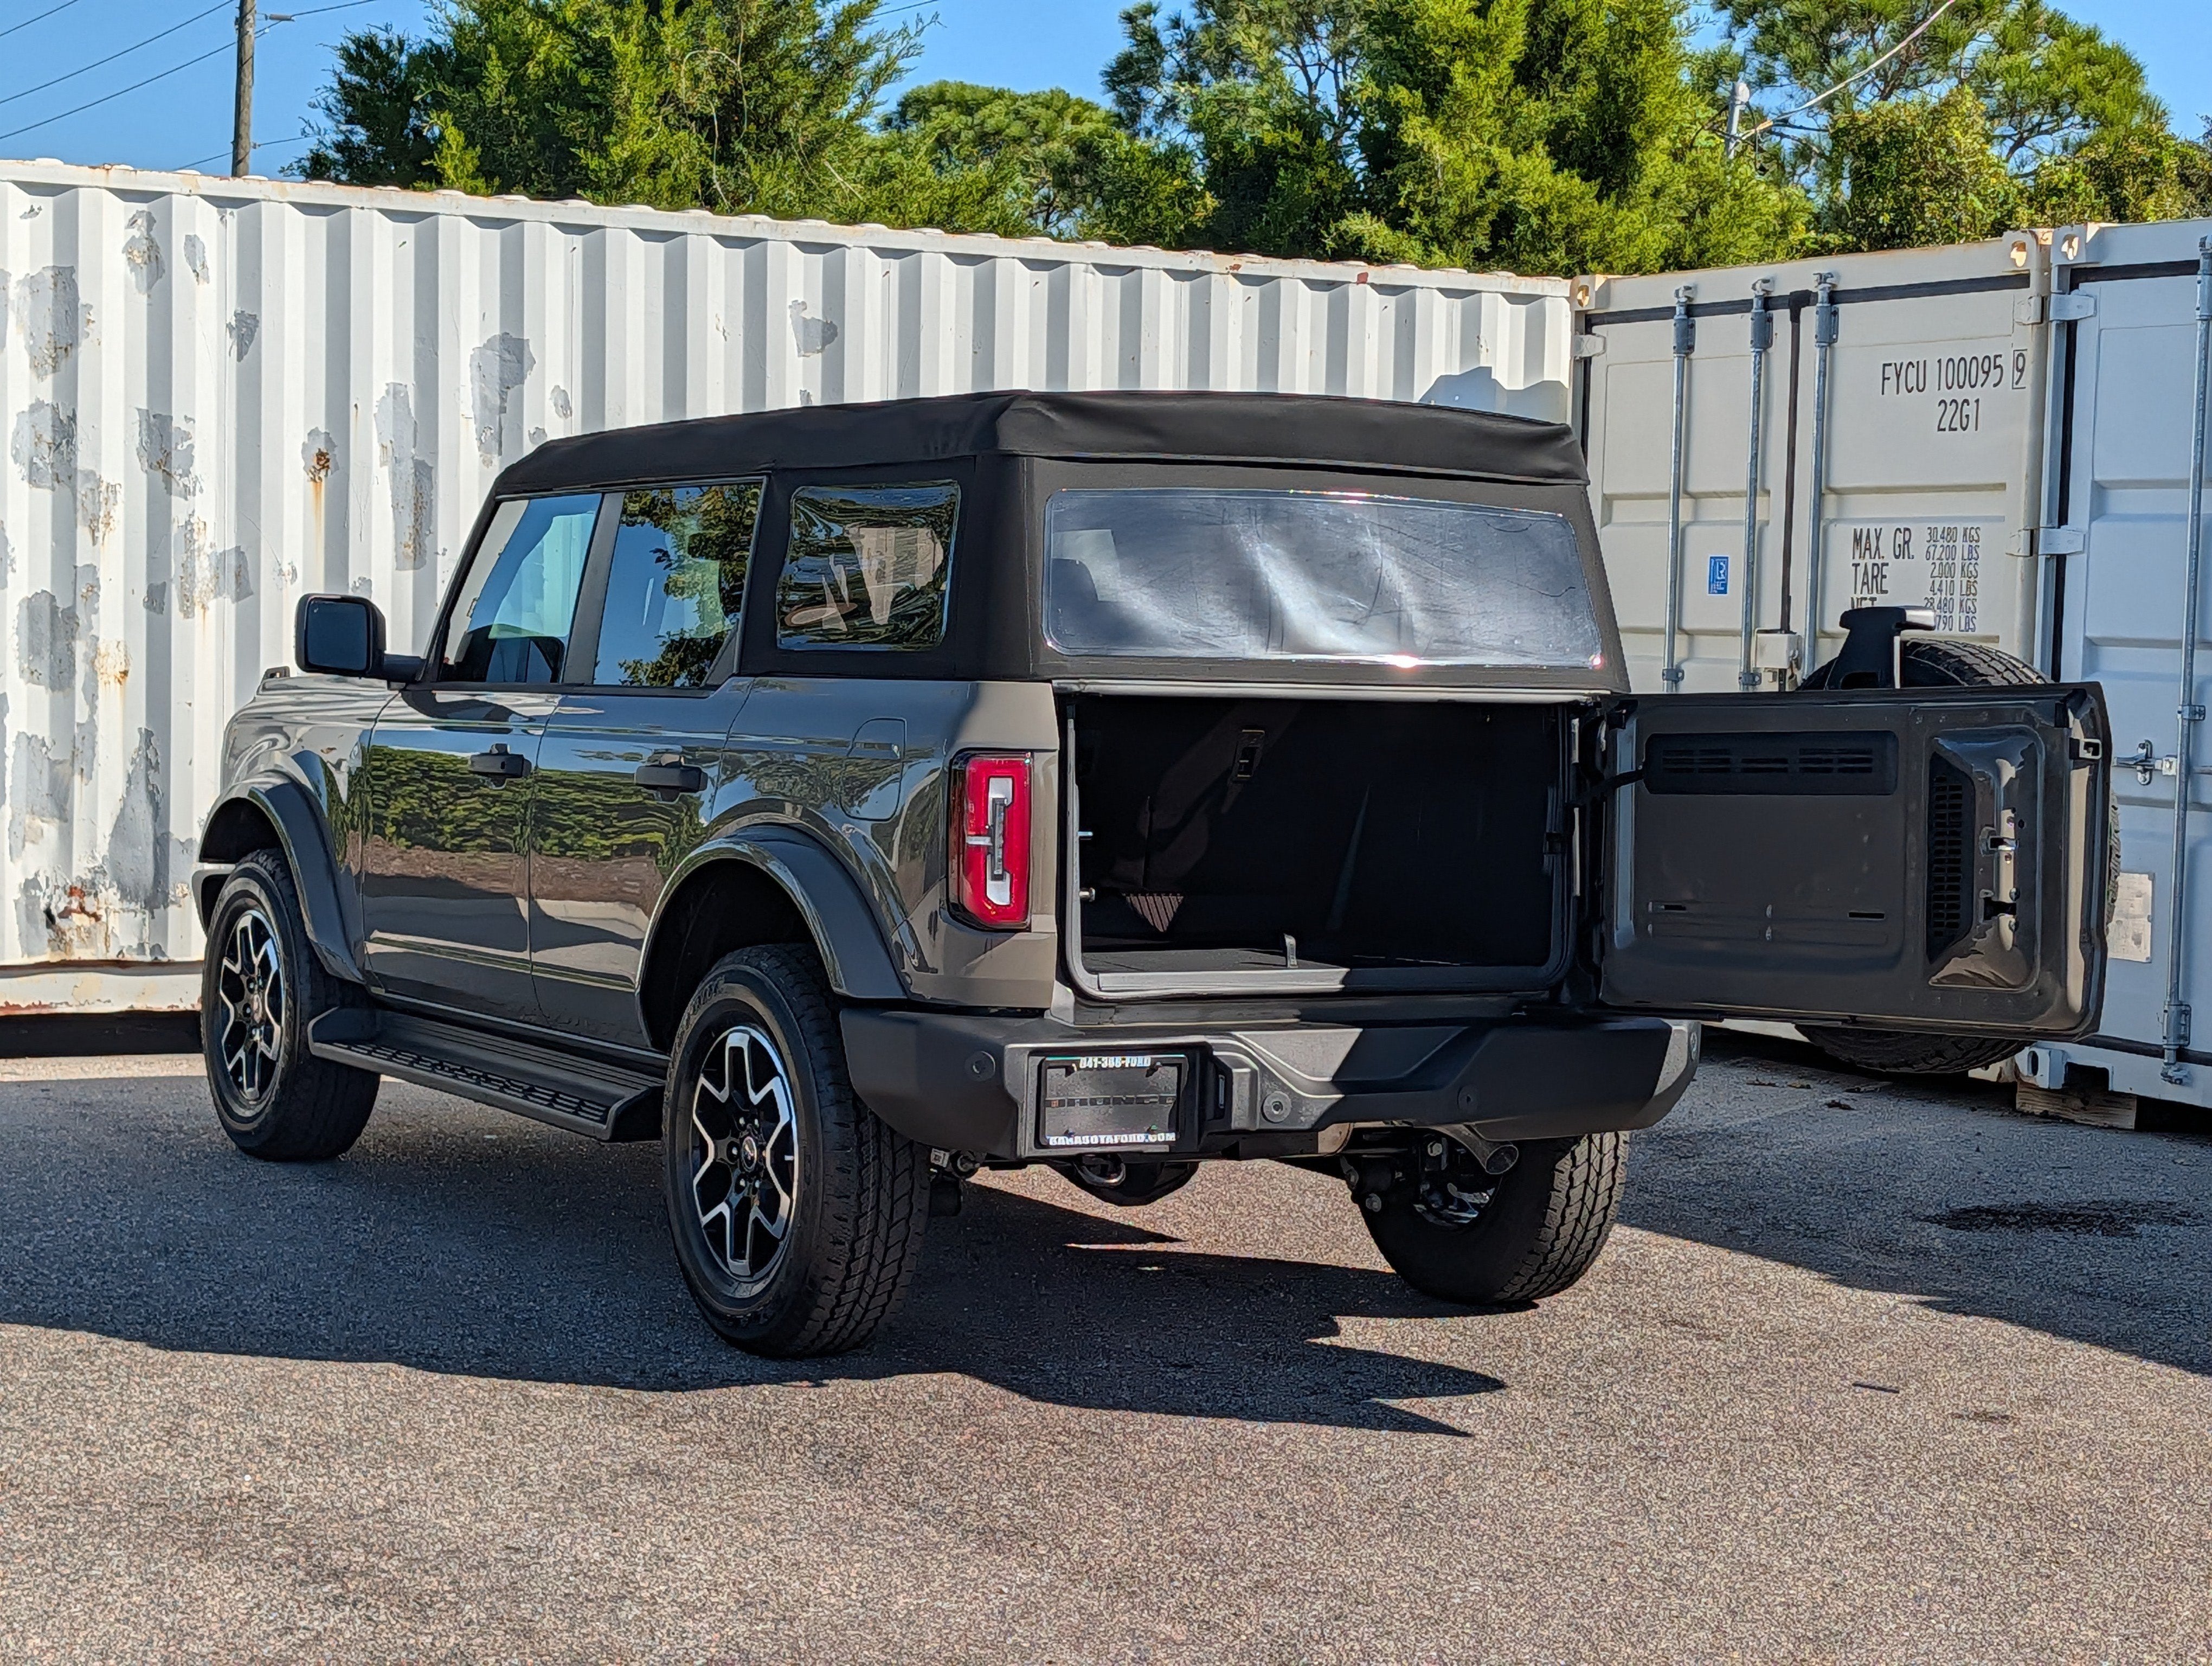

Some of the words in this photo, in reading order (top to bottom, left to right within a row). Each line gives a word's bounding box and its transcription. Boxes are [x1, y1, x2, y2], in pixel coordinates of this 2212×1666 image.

[1881, 360, 1926, 395] FYCU
[1937, 354, 2003, 391] 100095
[2015, 353, 2026, 385] 9
[1937, 398, 1980, 432] 22G1
[1852, 528, 1885, 560] MAX.
[1893, 528, 1914, 560] GR.
[1962, 527, 1980, 543] KGS
[1961, 544, 1979, 561] LBS
[1851, 562, 1889, 594] TARE
[1960, 562, 1979, 579] KGS
[1959, 580, 1978, 597] LBS
[1959, 598, 1977, 614] KGS
[1958, 615, 1977, 632] LBS
